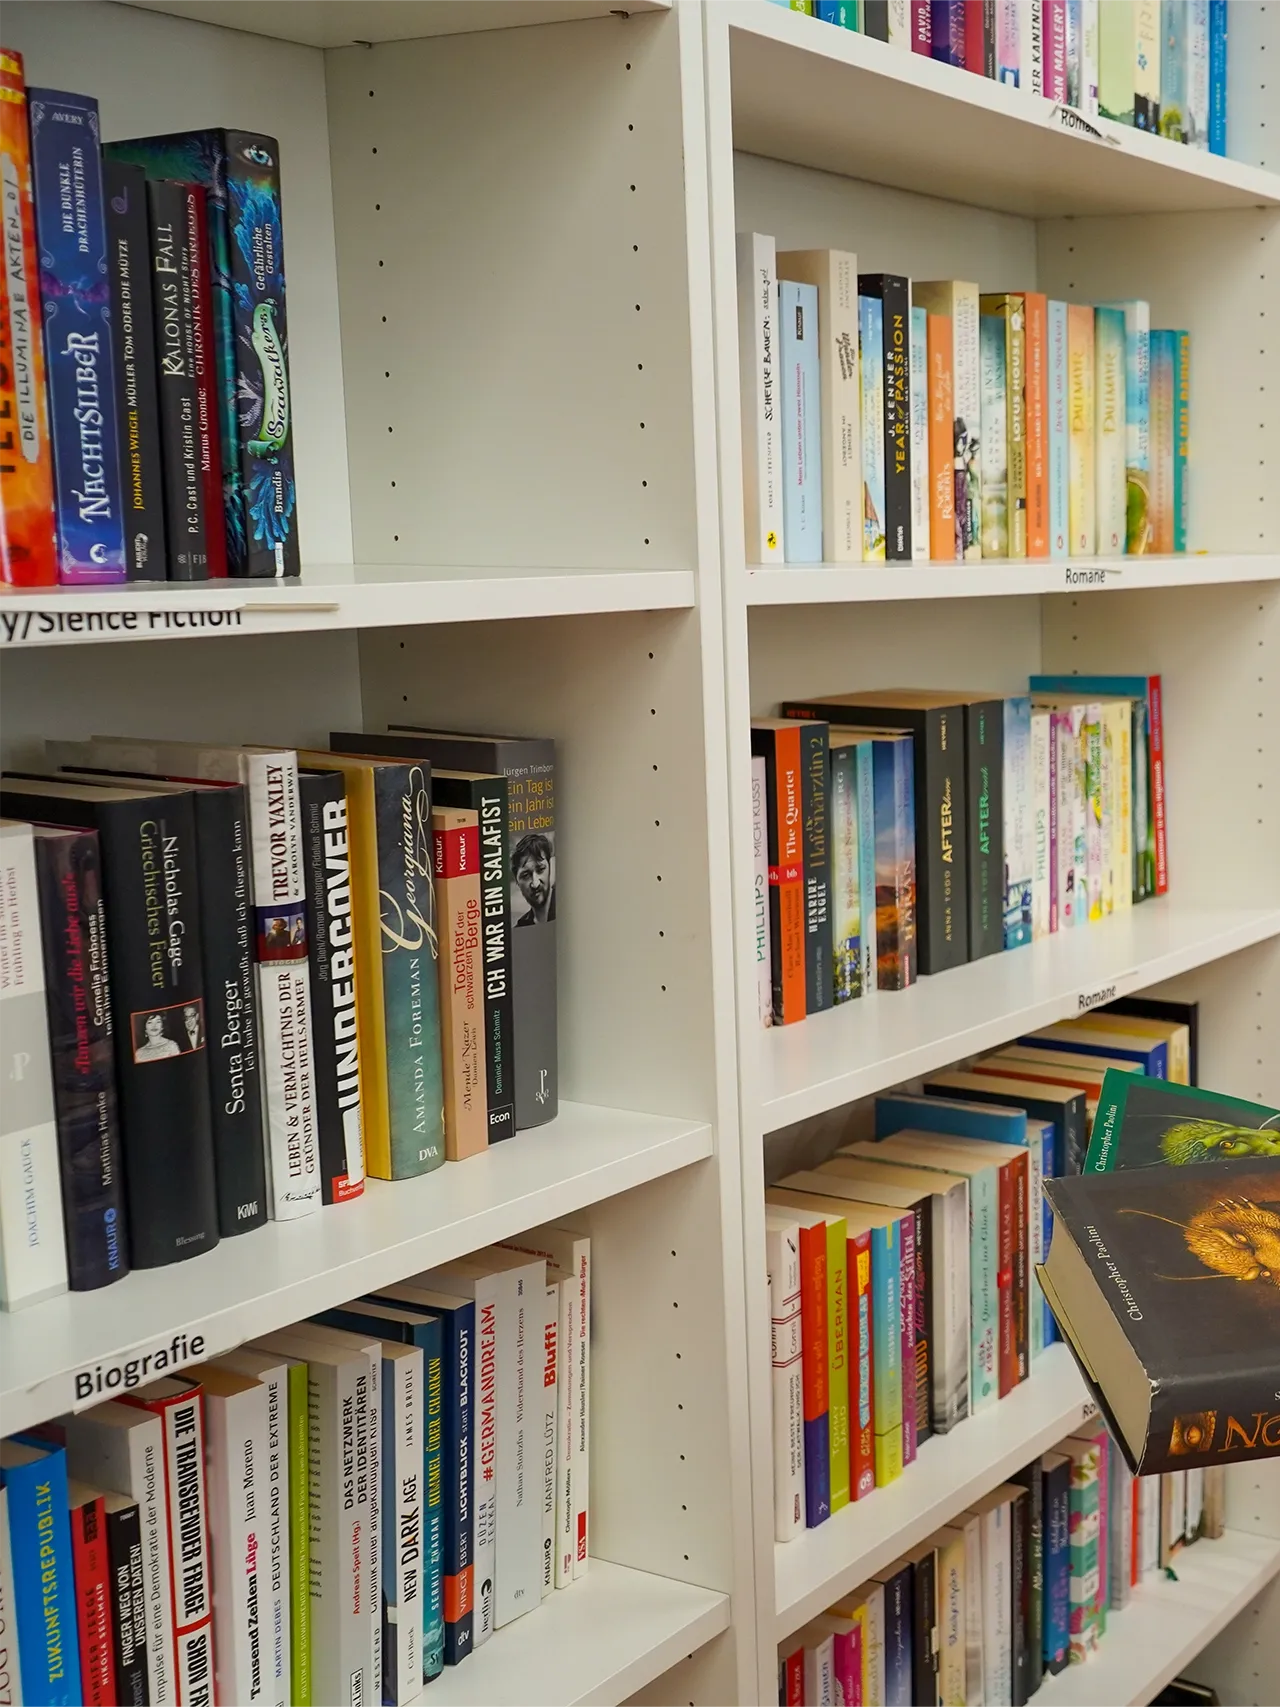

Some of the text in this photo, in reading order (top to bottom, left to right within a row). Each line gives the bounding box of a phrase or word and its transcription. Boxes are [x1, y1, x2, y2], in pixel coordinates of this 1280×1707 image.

[1053, 4, 1065, 71] MALLERY
[59, 162, 74, 232] DIE DUNKLE
[262, 223, 275, 275] Gestalten
[154, 222, 186, 377] KALONAS FALL
[13, 292, 35, 441] DIE ILLUMINAE
[117, 238, 145, 510] JOHANNES WEIGEL MÜLLER TOM ODER DIE MÜTZE
[886, 350, 895, 420] KENNER
[893, 313, 906, 474] YEAR PASSION
[1011, 337, 1021, 442] LOTUS HOUSE
[61, 329, 111, 522] NACHTSILBER
[180, 396, 197, 510] Cast und Kristin Cast
[272, 470, 284, 513] Brandis
[1065, 567, 1106, 585] Romane
[525, 779, 544, 796] Tag
[810, 736, 824, 747] 2
[266, 764, 290, 901] TREVOR YAXLEY
[286, 764, 299, 884] CAROLYN VANDERWAL
[379, 766, 438, 960] Georgiana
[457, 833, 468, 871] Knaur.
[785, 769, 798, 858] The Quartet
[138, 819, 168, 989] Griechisches Feuer
[162, 835, 186, 967] Nicholas Gage
[480, 796, 508, 1001] ICH WAR EIN SALAFIST
[752, 817, 766, 962] PHILLIPS MICH
[816, 882, 828, 923] ENGEL
[943, 870, 953, 941] ANNA TODD
[88, 914, 104, 1026] Cornelia Froboess
[231, 820, 255, 1072] Ich habe ich fliegen kann
[321, 797, 362, 1109] UNDERCOVER
[453, 910, 467, 994] Tochter der
[463, 898, 480, 1010] schwarzen Berge
[1077, 985, 1117, 1010] Romane
[220, 979, 246, 1115] Senta Berger
[277, 971, 302, 1178] LEBEN & VERMÄCHTNIS DER
[294, 977, 315, 1174] GRÜNDER DER HEILSARMEE
[96, 1091, 113, 1186] Matthias Henke
[416, 1146, 439, 1161] DVA
[489, 1110, 510, 1125] Econ
[1094, 1103, 1118, 1172] Christopher Paolini
[830, 1269, 845, 1371] ÜBERMAN
[1083, 1224, 1144, 1321] Christopher Paolini
[74, 1333, 206, 1401] Biografie
[515, 1308, 524, 1366] des Herzens
[544, 1321, 557, 1388] Bluff!
[914, 1339, 928, 1387] TODD
[354, 1375, 368, 1504] DER IDENTITÄREN
[404, 1412, 414, 1447] JAMES
[458, 1328, 470, 1523] LICHTBLICK statt BLACKOUT
[479, 1303, 496, 1483] #GERMANDREAM
[268, 1381, 282, 1592] DEUTSCHLAND DER EXTREME
[341, 1395, 355, 1511] DAS NETZWERK
[543, 1410, 555, 1513] MANFRED LÜTZ
[173, 1404, 205, 1619] DIE TRANSGENDER FRAGE
[399, 1474, 419, 1604] NEW DARK AGE
[35, 1480, 65, 1683] ZUKUNFTSREPUBLIK
[117, 1564, 135, 1667] FINGER WEG VON
[129, 1542, 147, 1648] UNSEREN DATEN!
[143, 1445, 168, 1704] Impulse für eine Demokratie der Moderne
[242, 1439, 262, 1701] Tausend Zeilen Lüge Juan Moreno
[352, 1574, 361, 1615] Andreas
[458, 1531, 469, 1614] VINCE EBERT
[480, 1596, 491, 1632] berlin
[543, 1548, 552, 1586] KNAUR
[185, 1633, 208, 1684] SHON
